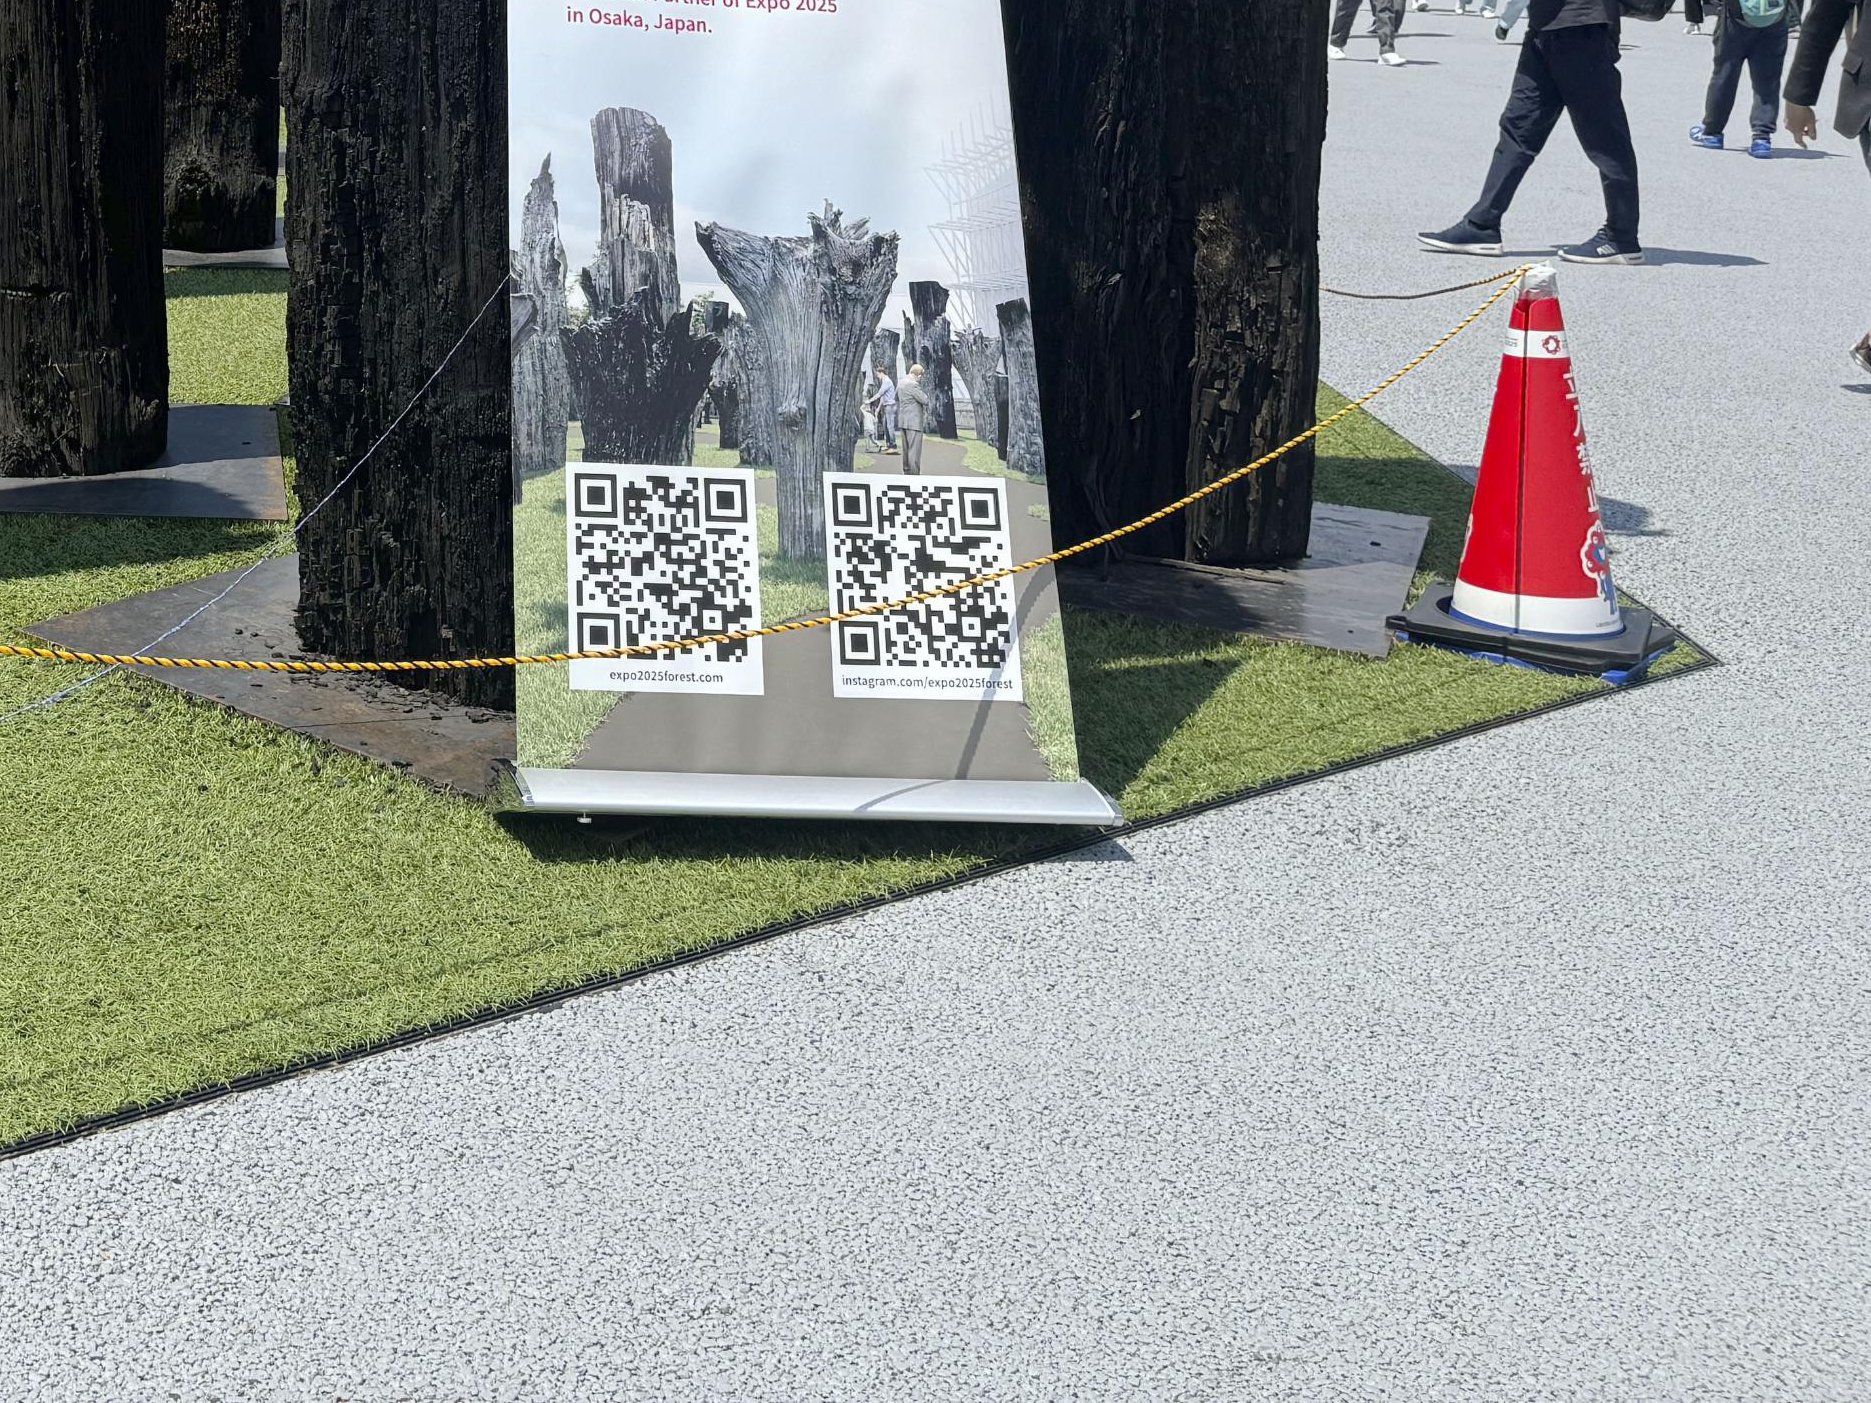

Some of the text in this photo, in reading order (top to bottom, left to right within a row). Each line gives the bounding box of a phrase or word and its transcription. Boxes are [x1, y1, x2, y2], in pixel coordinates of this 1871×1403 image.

[567, 6, 713, 35] in Osaka, Japan.
[609, 670, 724, 683] expo2025forest.com
[842, 675, 1013, 690] instagram.com/expo2025forest
